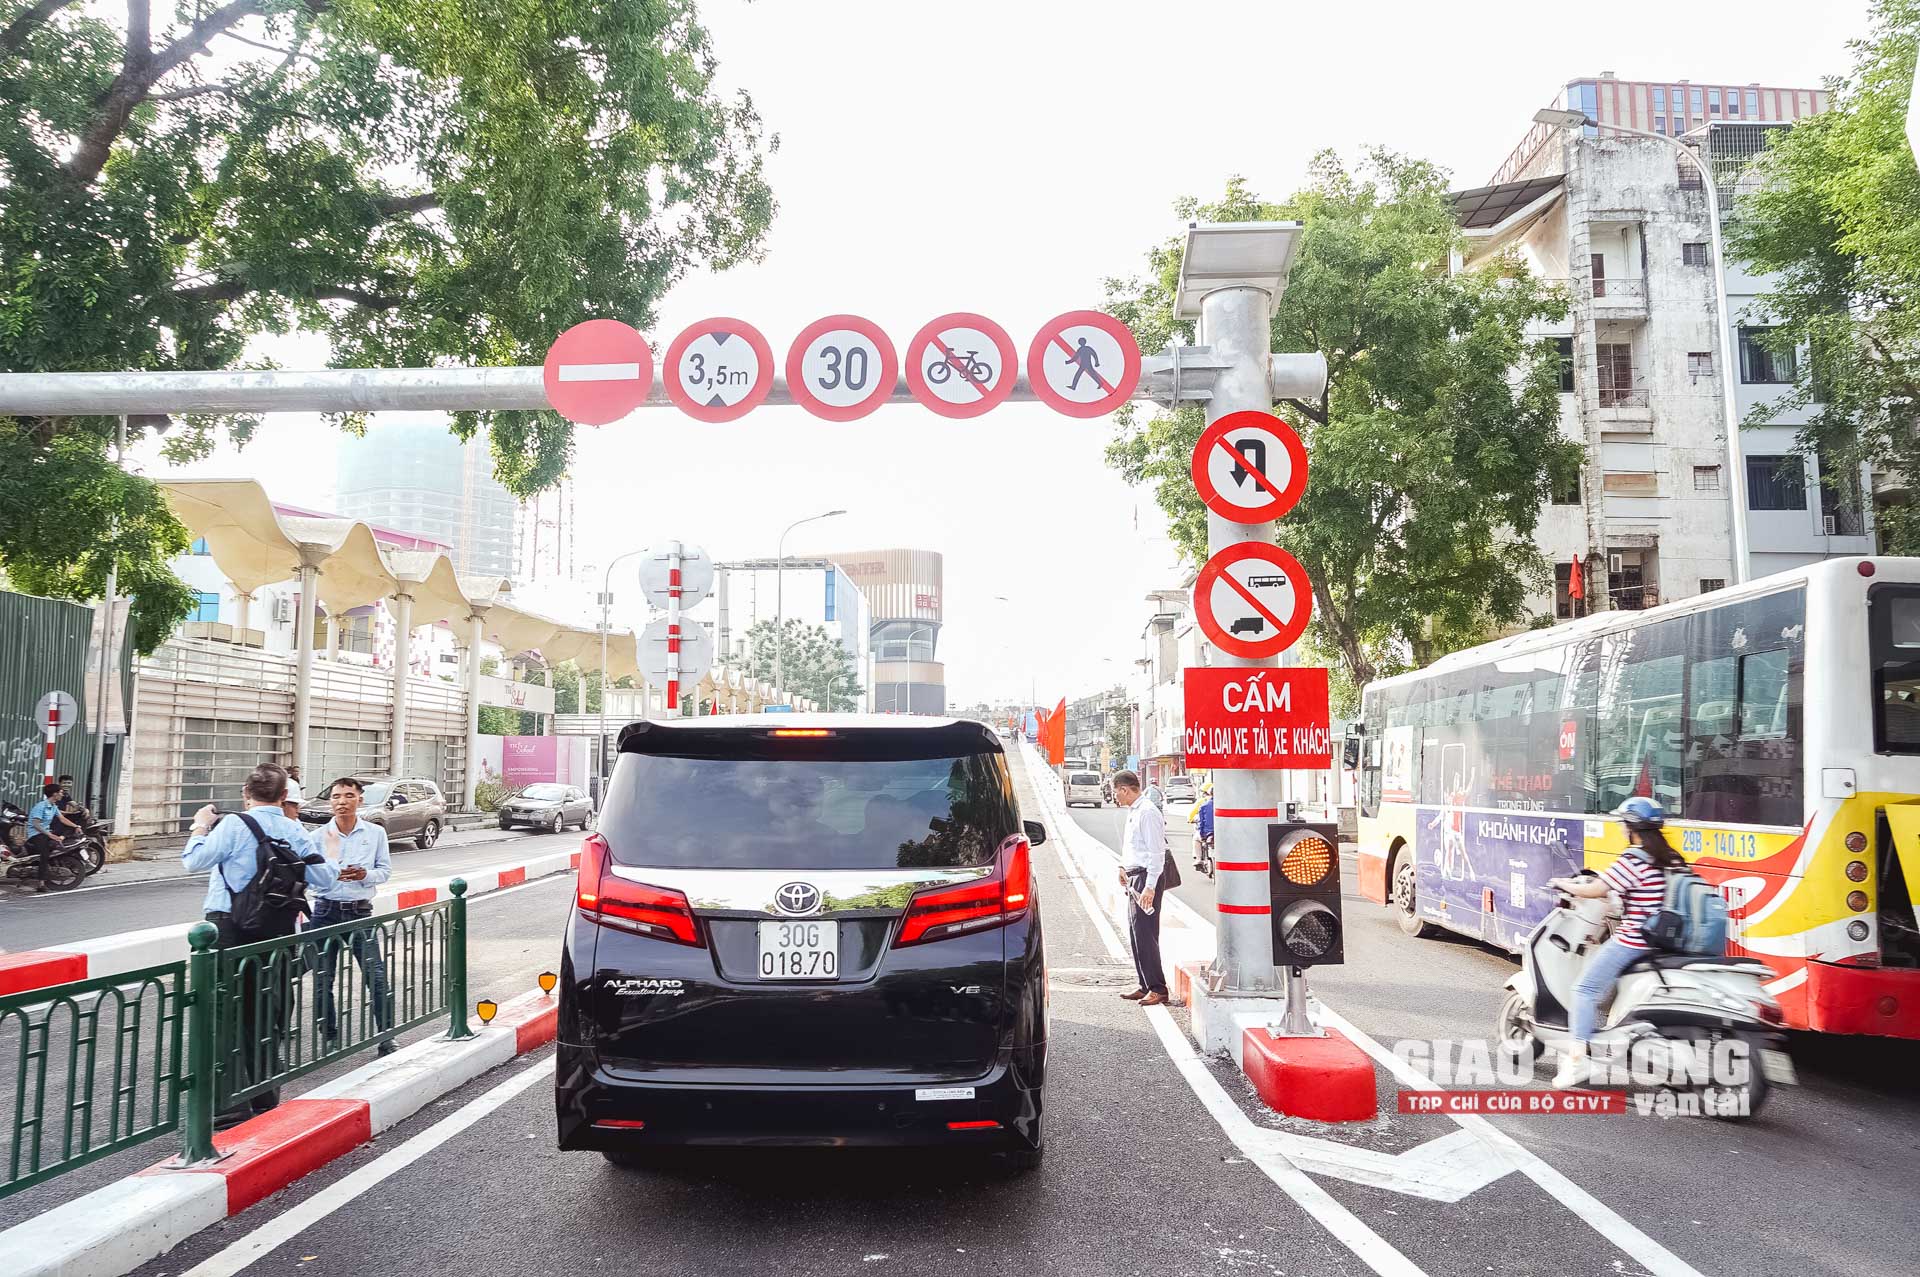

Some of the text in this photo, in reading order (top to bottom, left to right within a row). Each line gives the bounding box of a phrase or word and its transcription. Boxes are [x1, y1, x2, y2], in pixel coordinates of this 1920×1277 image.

[818, 345, 868, 391] 30
[1222, 671, 1291, 713] CẤM
[1185, 718, 1331, 759] CÁC LOẠI XE TẢI, XE KHÁCH
[1478, 816, 1528, 844] KHOẢNH
[1683, 830, 1702, 852] 29B
[1714, 832, 1756, 858] 140.13
[778, 924, 820, 948] 30G
[762, 951, 836, 976] 018.70
[603, 980, 684, 989] ALPHARD
[950, 985, 981, 994] V6
